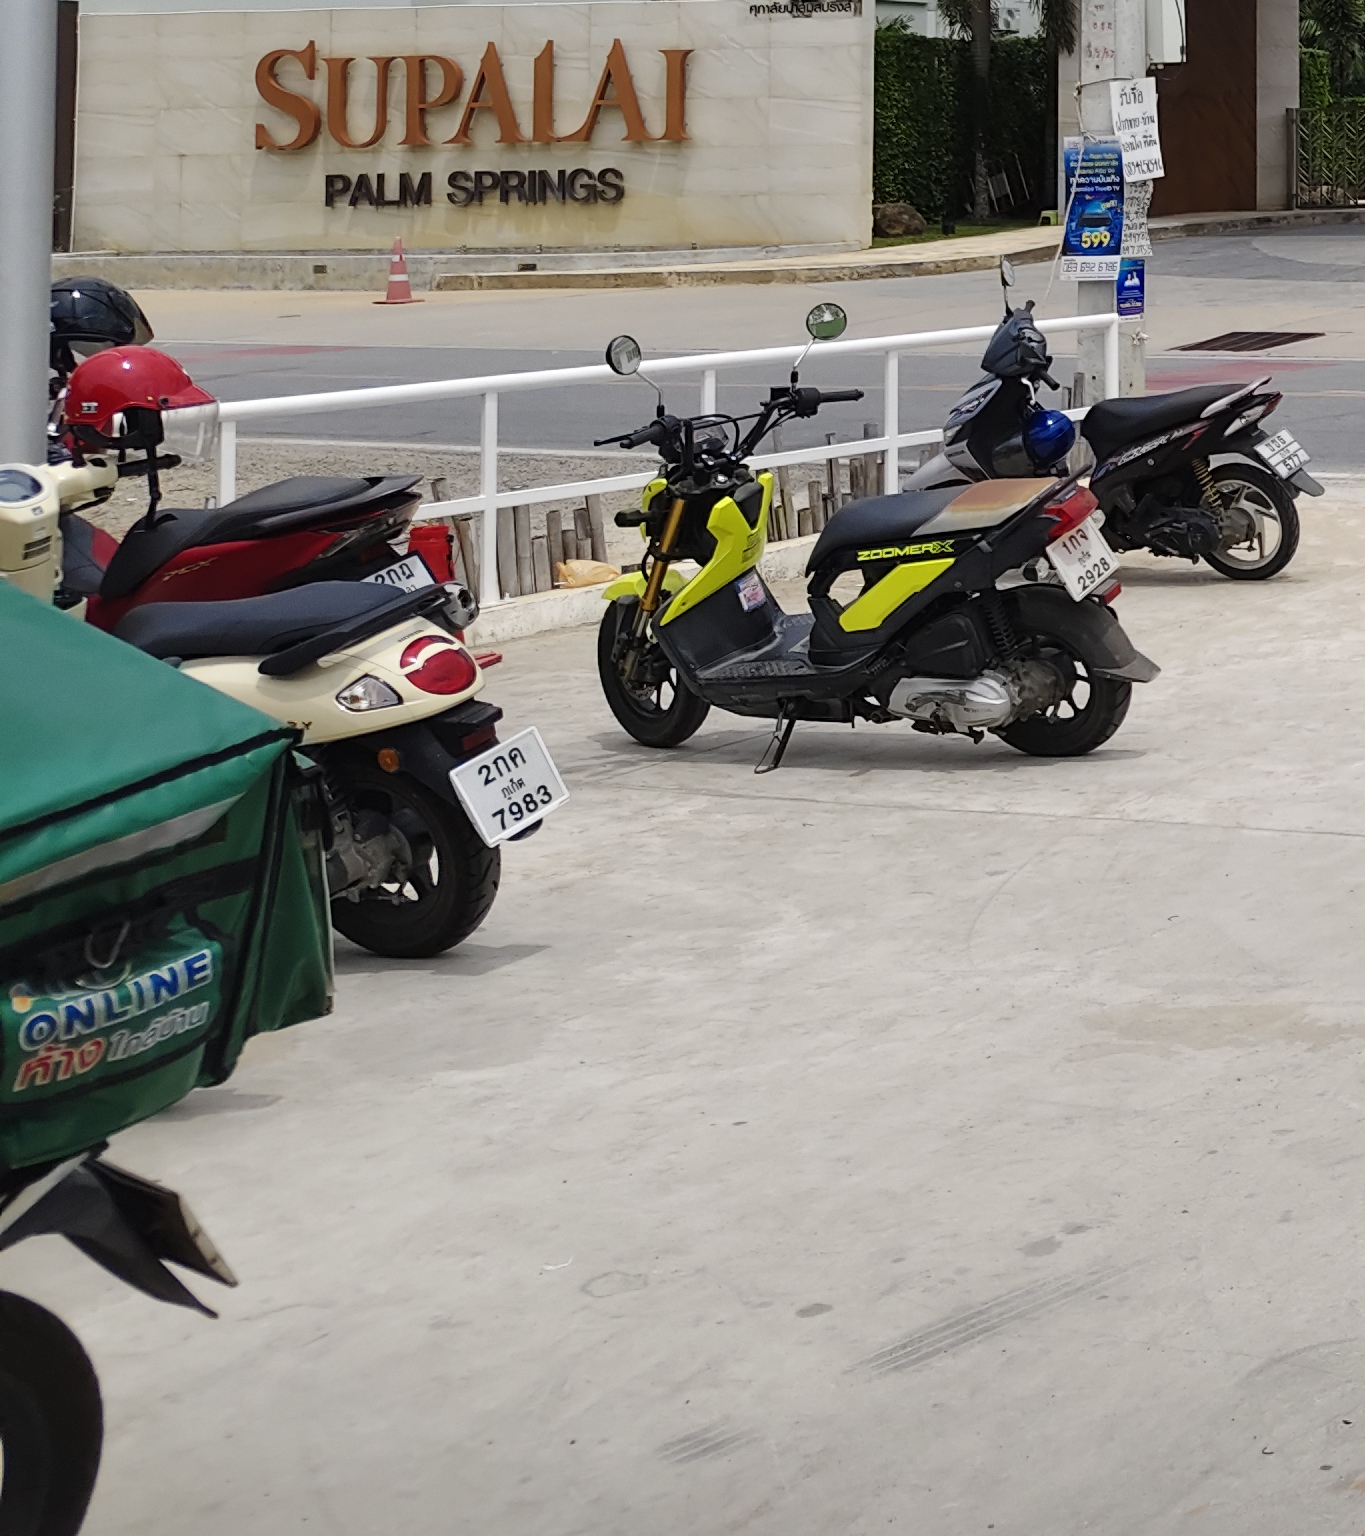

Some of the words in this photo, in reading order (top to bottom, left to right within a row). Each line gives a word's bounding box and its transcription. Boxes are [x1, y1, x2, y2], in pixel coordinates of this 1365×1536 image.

[255, 38, 695, 151] SUPALAI
[324, 171, 432, 207] PALM
[447, 168, 625, 206] SPRINGS
[1081, 230, 1111, 249] 599
[1078, 557, 1110, 592] 2928
[477, 747, 527, 787] 2กค
[491, 784, 553, 831] 7983
[501, 777, 526, 801] ภูเก็ต
[20, 949, 212, 1051] ONLINE
